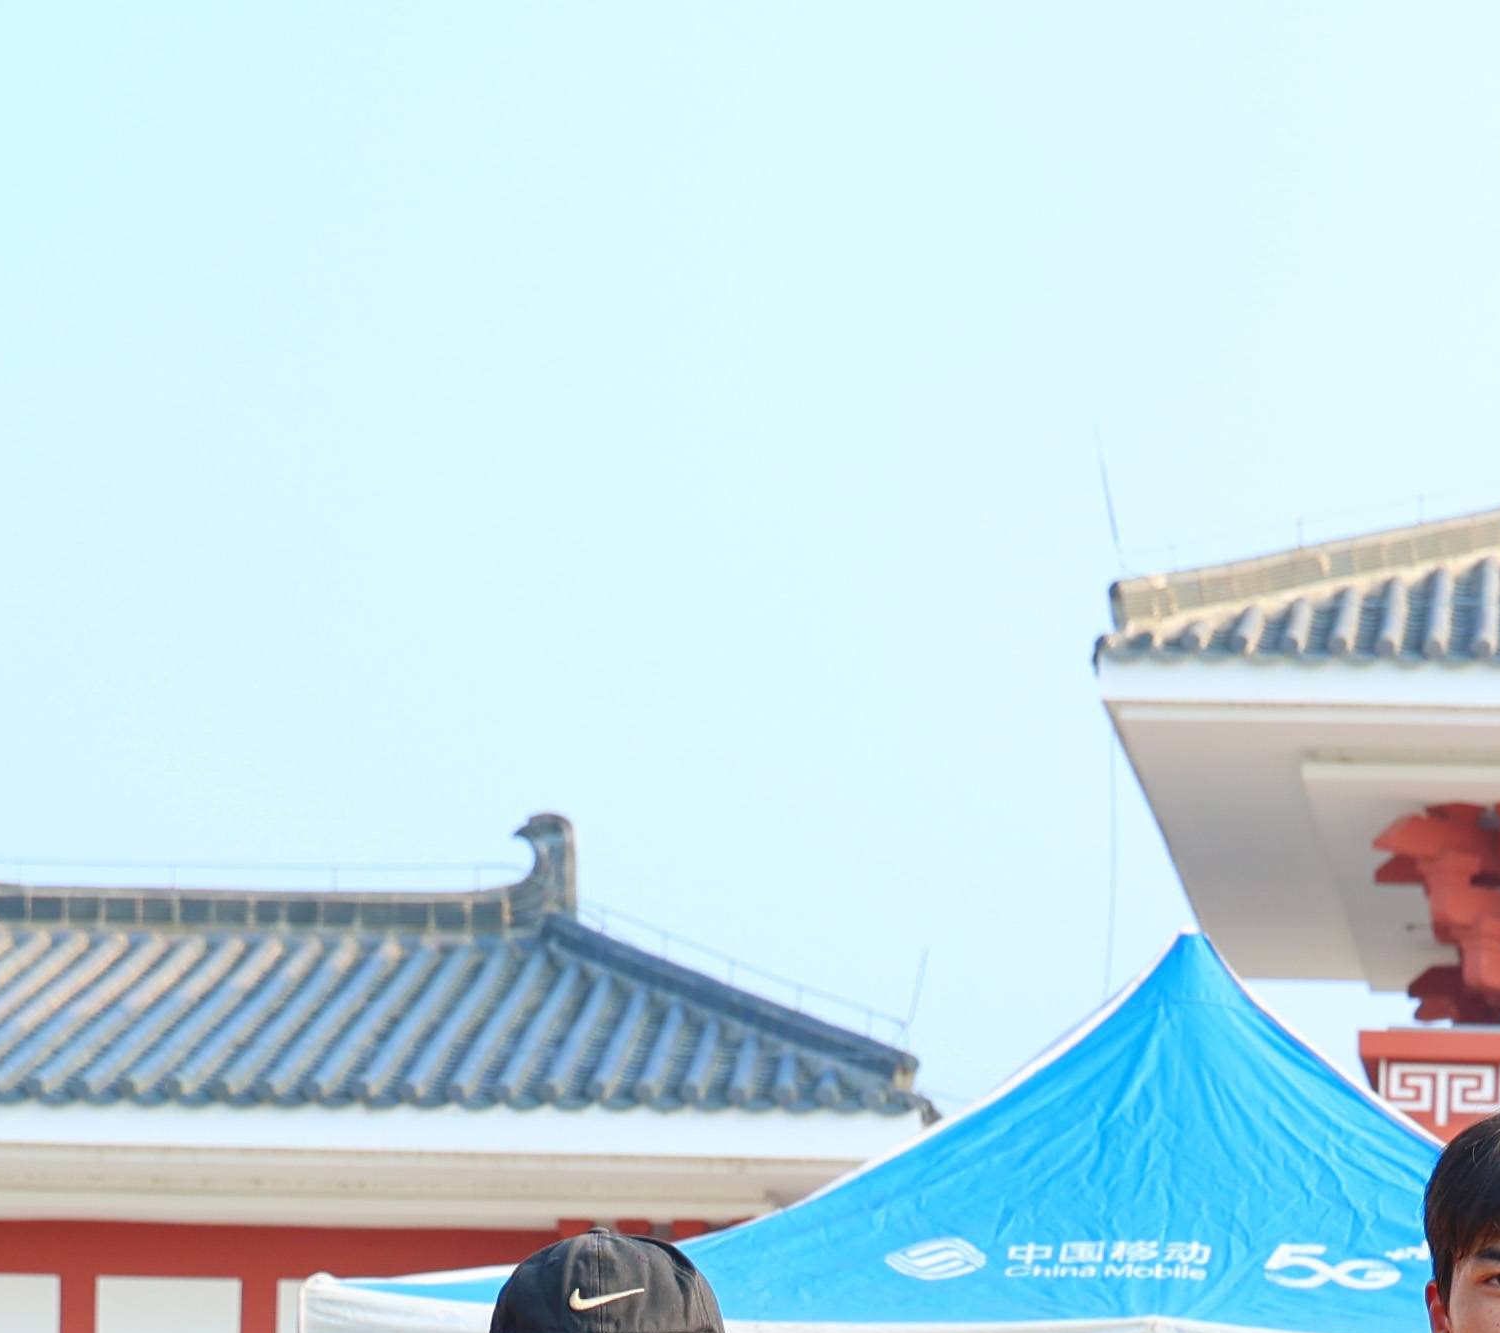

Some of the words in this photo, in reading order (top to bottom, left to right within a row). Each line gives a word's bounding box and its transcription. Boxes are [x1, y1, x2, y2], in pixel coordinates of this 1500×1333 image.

[1007, 1241, 1212, 1265] 中国移动
[1004, 1263, 1097, 1278] China
[1104, 1263, 1208, 1280] Mobile
